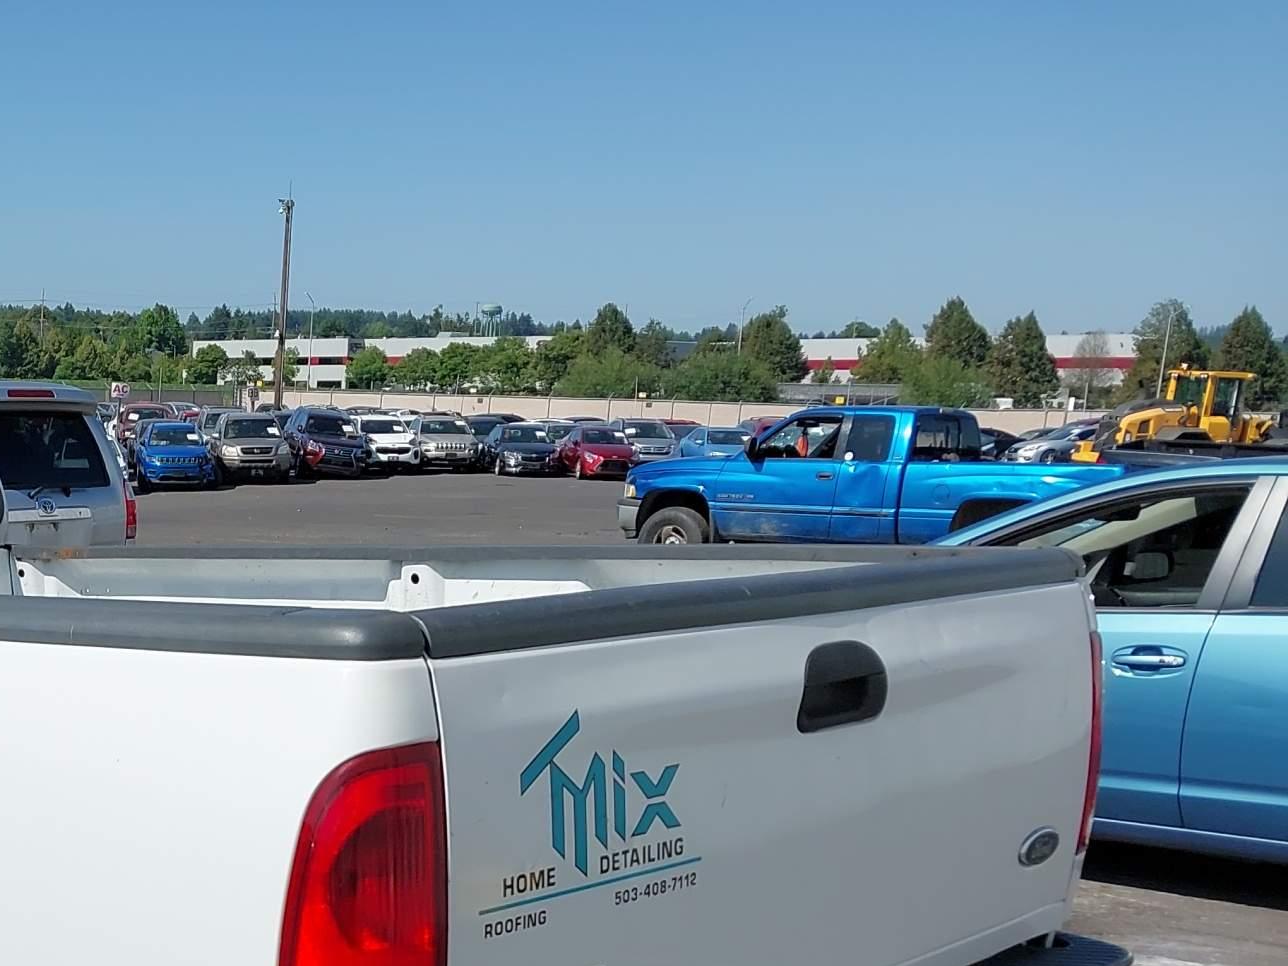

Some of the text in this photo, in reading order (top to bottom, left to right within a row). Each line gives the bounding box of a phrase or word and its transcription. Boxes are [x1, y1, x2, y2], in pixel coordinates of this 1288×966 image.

[113, 384, 128, 394] AC
[502, 837, 685, 898] HOME DETAILING
[484, 872, 697, 939] ROOFING 503-408-7112
